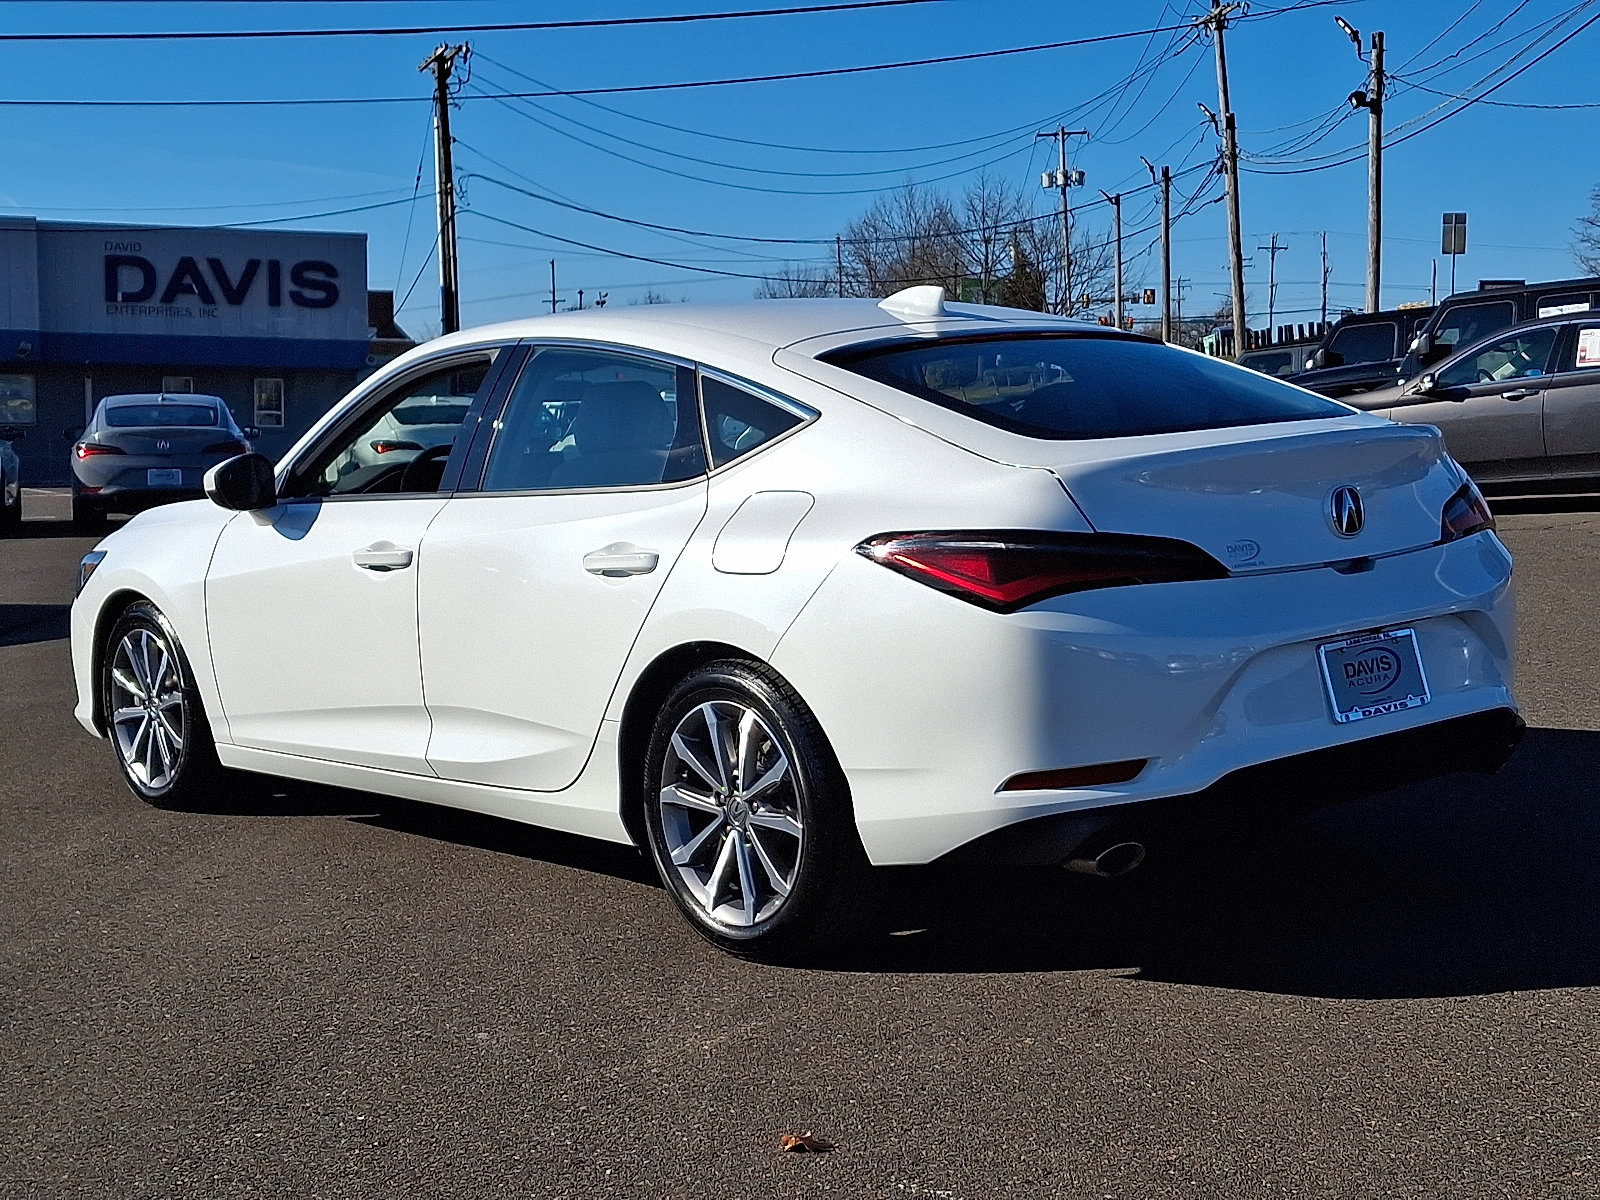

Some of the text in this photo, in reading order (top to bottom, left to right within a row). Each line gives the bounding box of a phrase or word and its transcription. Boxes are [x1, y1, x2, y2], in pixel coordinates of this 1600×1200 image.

[104, 241, 142, 252] DAVID
[104, 254, 339, 308] DAVIS
[1226, 543, 1255, 553] DAVIS
[1343, 655, 1392, 680] DAVIS
[1348, 672, 1391, 688] ACURA
[1361, 701, 1409, 717] DAVIS
